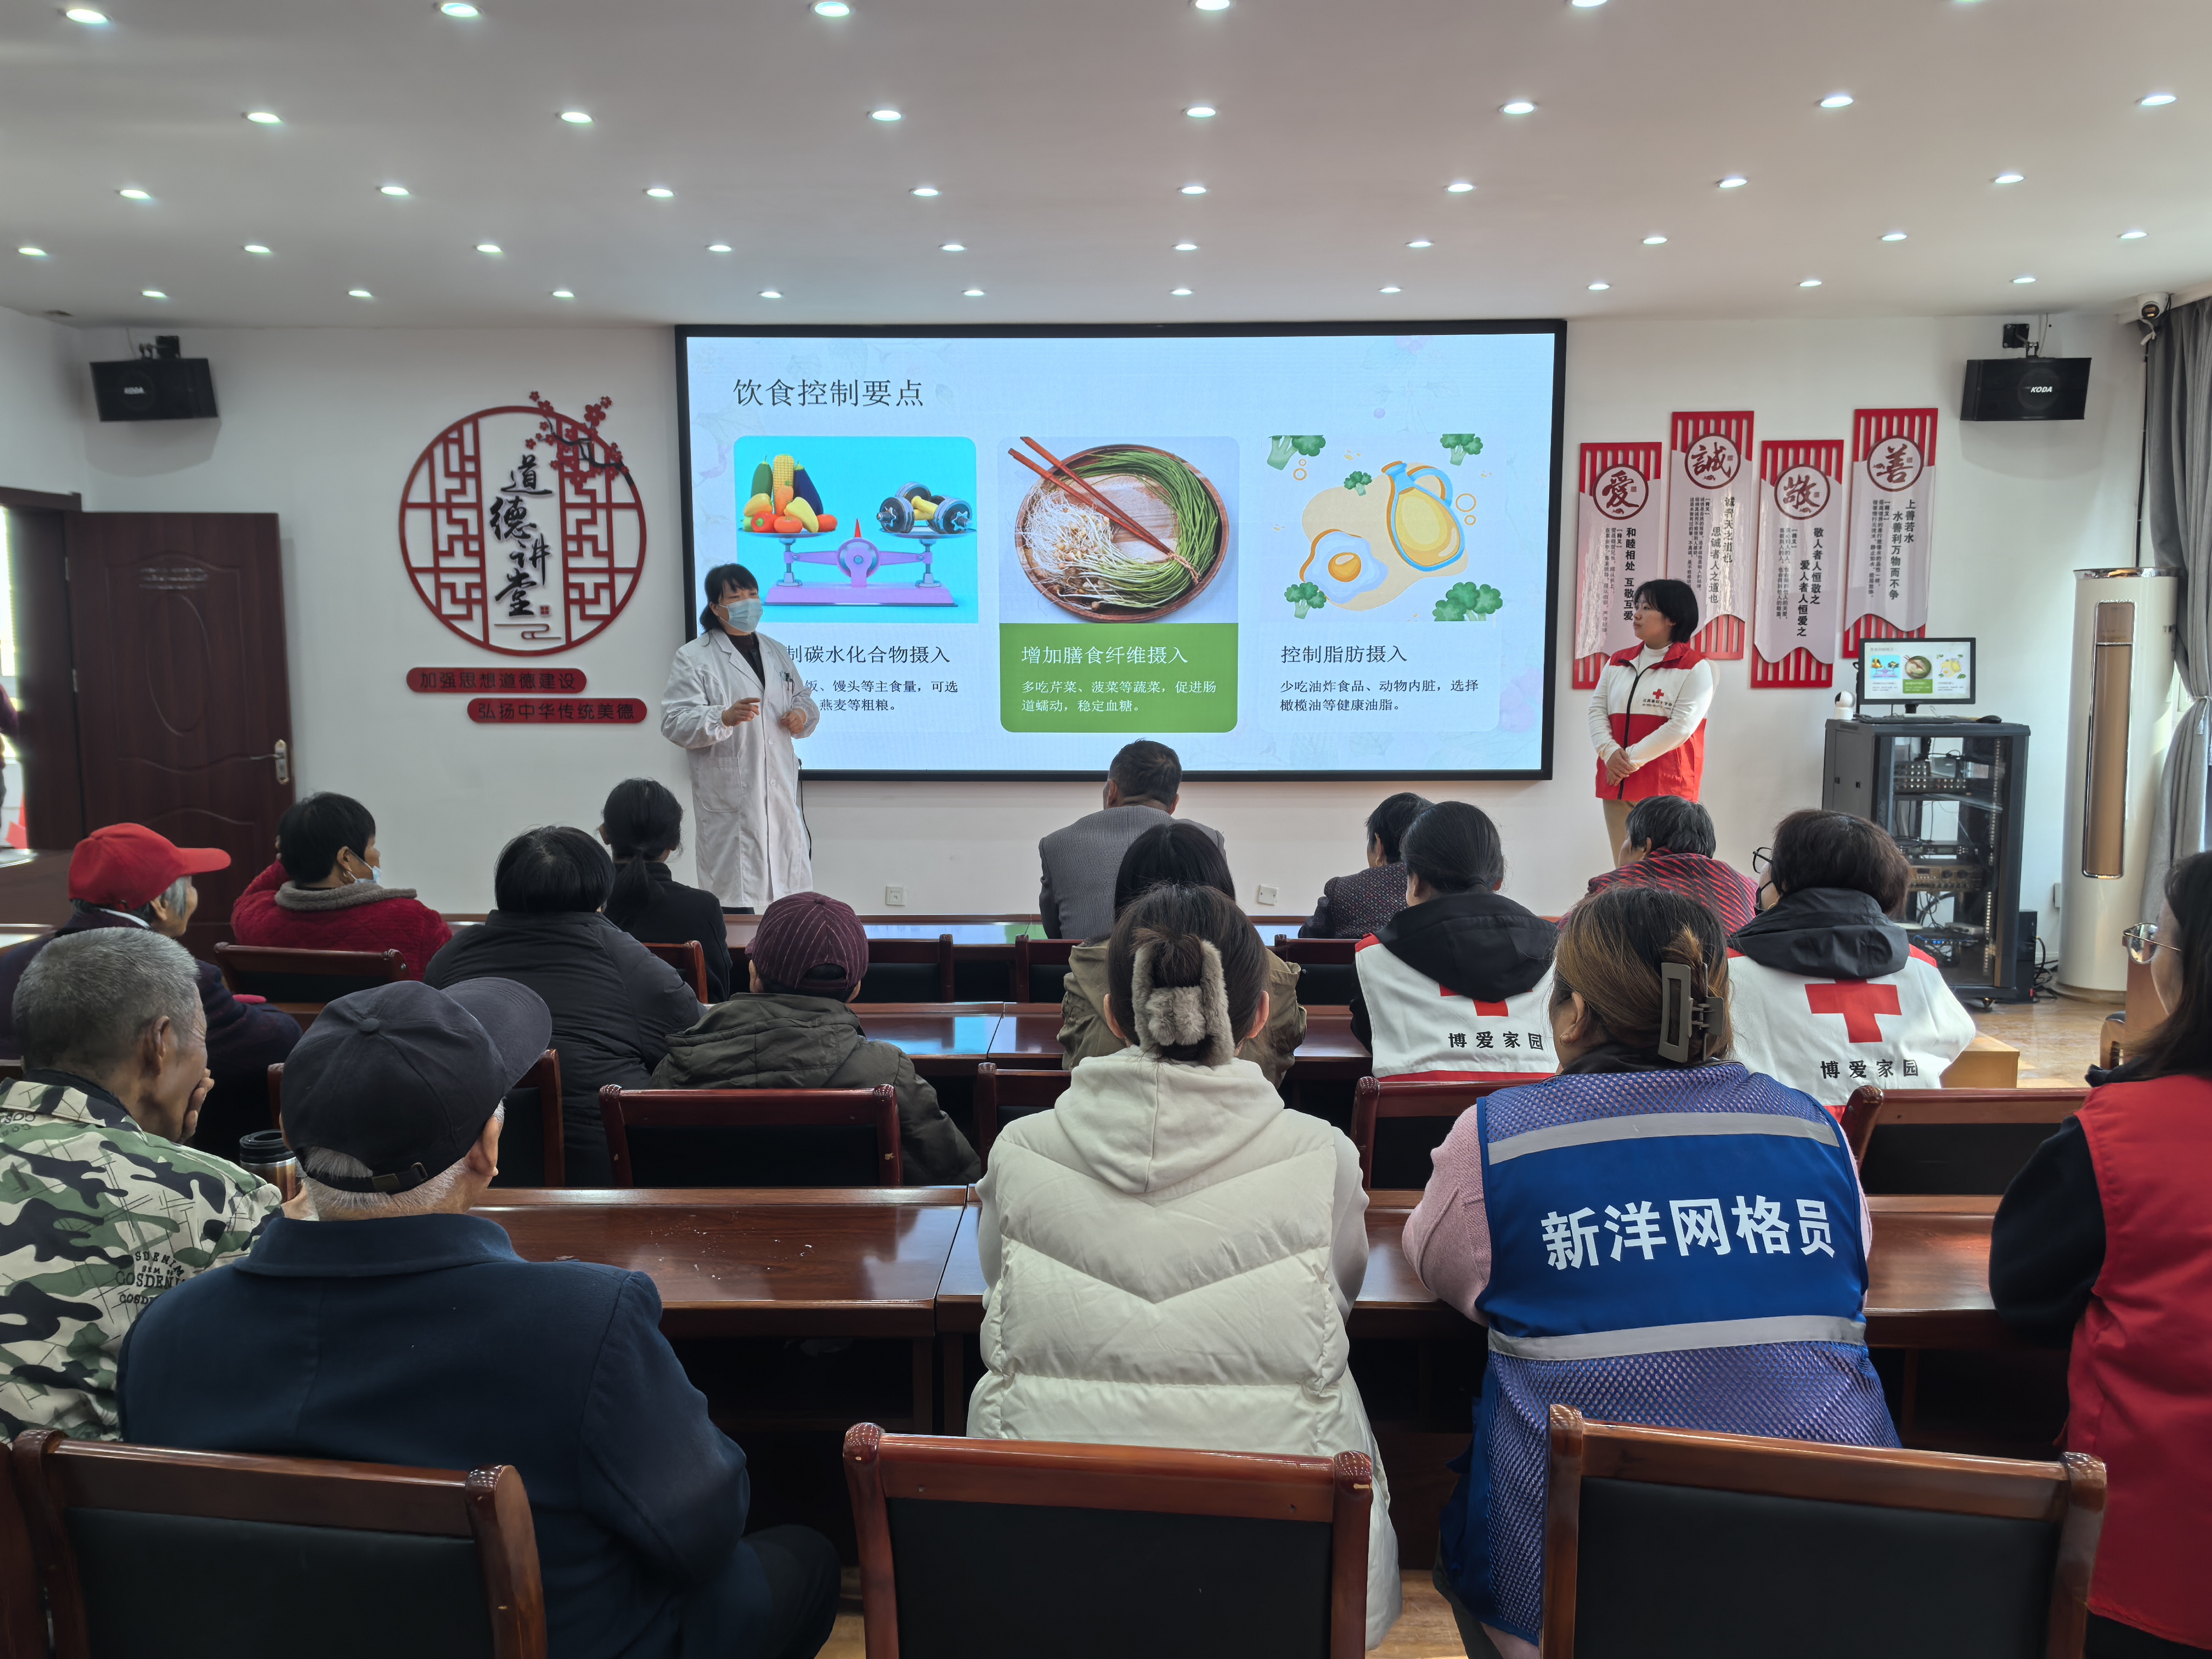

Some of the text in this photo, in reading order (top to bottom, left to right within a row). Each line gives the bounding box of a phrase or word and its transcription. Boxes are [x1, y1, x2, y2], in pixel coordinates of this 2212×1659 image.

[733, 379, 923, 407] 饮食控制要点
[1904, 499, 1917, 543] 上善若水
[490, 454, 553, 617] 道德讲堂
[1889, 511, 1903, 600] 水善利万物而不争
[1623, 527, 1636, 621] 和睦相处 互敬互爱
[1810, 527, 1824, 604] 敬人者人恒敬之
[1797, 559, 1810, 636] 爱人者人恒爱之
[786, 645, 950, 664] 制碳水化合物摄入
[1021, 646, 1188, 664] 增加膳食纤维摄入
[1280, 645, 1407, 663] 控制脂肪摄入
[420, 672, 576, 690] 加强思想道德建设
[1021, 680, 1216, 694] 多吃芹菜、菠菜等蔬菜，促进肠
[1280, 679, 1479, 693] 少吃油炸食品、动物内脏，选择
[478, 703, 634, 719] 弘扬中华传统美德
[819, 698, 895, 711] 燕麦等粗粮。
[1021, 699, 1140, 712] 道蠕动，稳定血糖。
[1280, 699, 1401, 711] 橄榄油等健康油脂。
[1448, 1031, 1544, 1050] 博爱家园
[1820, 1059, 1919, 1079] 博爱家园
[1541, 1195, 1835, 1270] 新洋网格员
